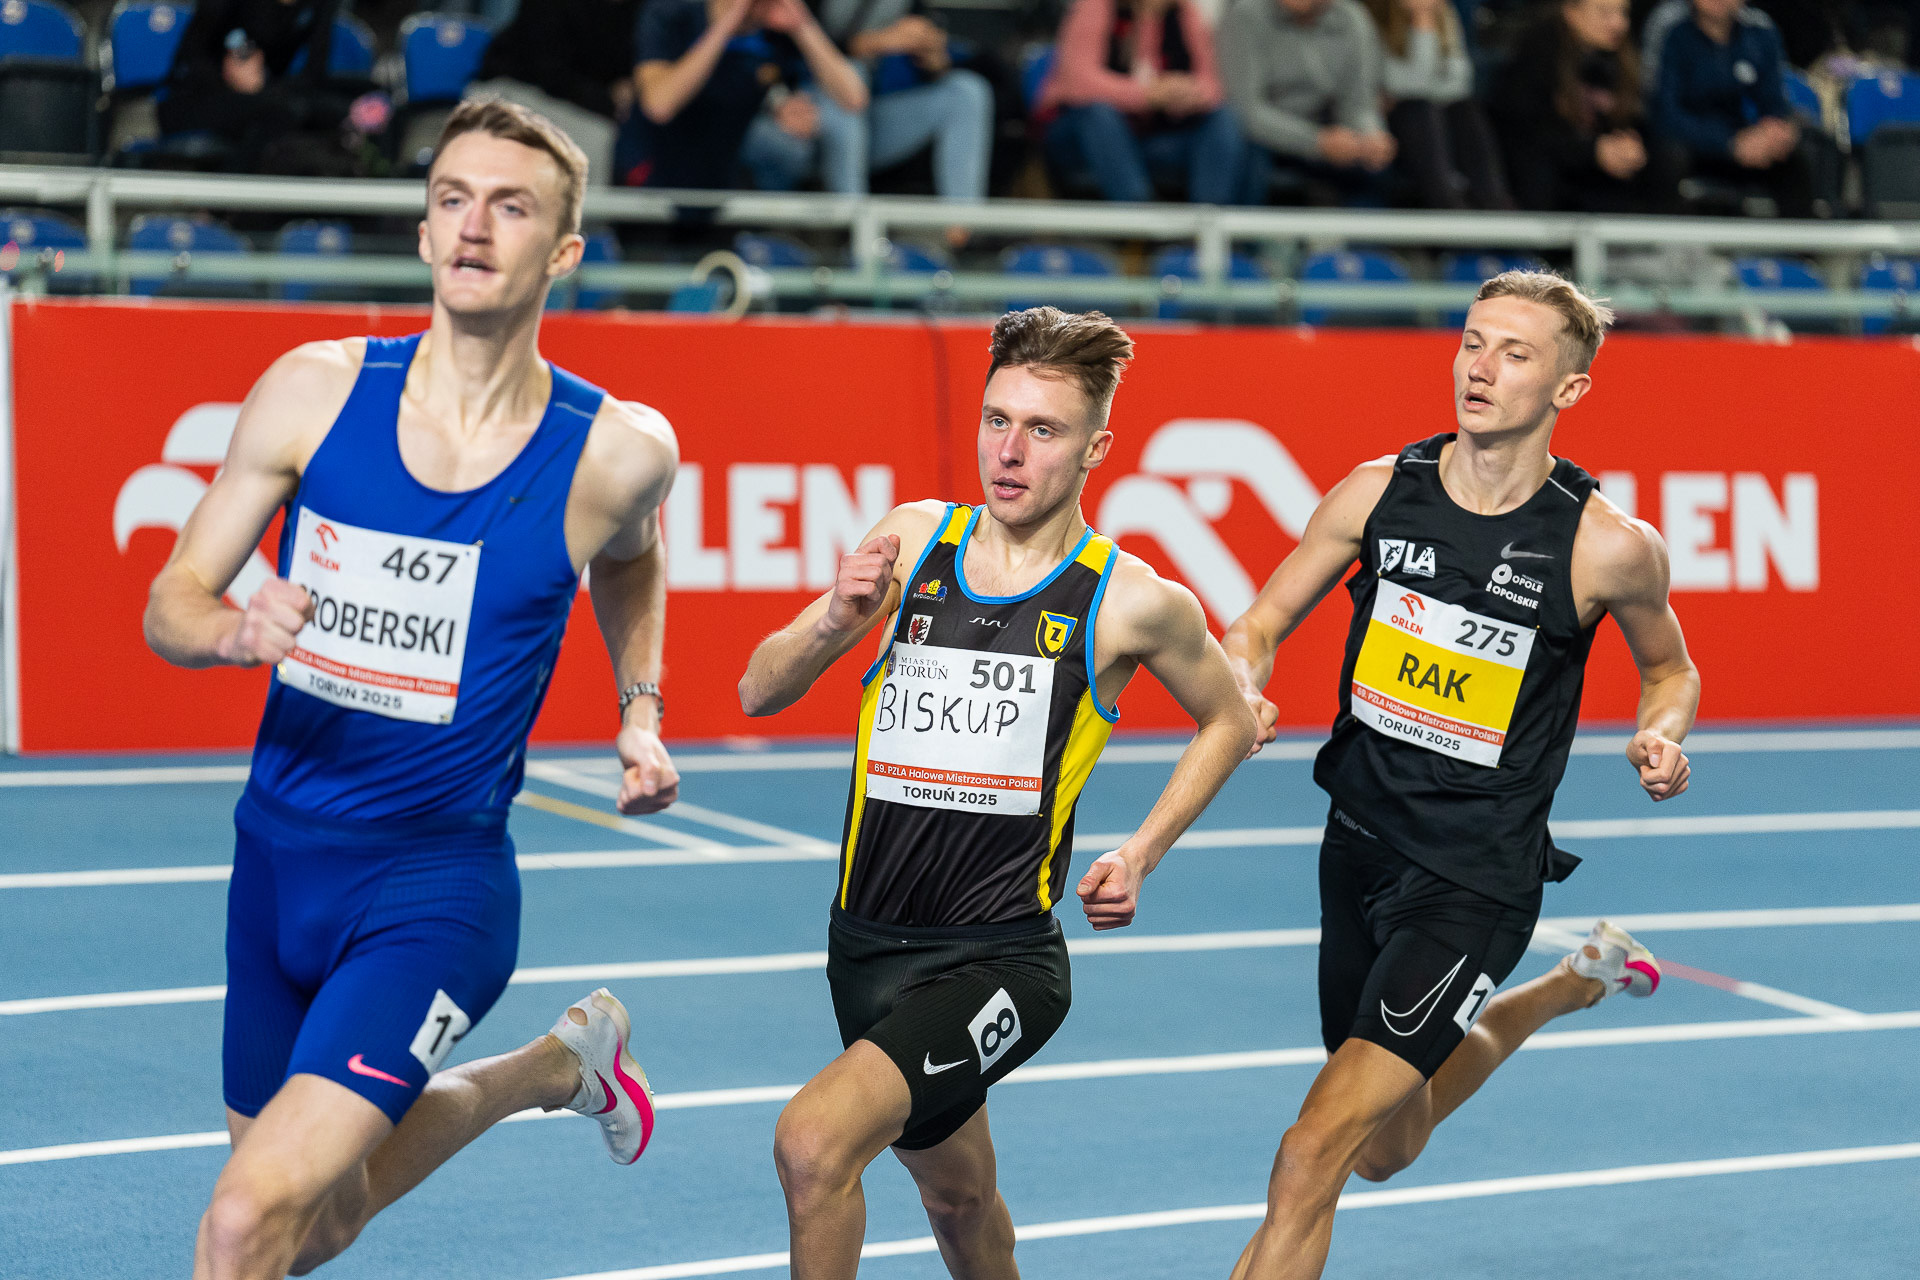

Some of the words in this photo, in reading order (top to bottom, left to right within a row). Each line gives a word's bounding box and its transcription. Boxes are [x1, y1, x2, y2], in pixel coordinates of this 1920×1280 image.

[660, 463, 896, 592] LEN
[382, 547, 458, 585] 467
[1492, 585, 1539, 610] OPOLSKIE
[1512, 575, 1543, 594] OPOLE
[302, 584, 456, 656] ROBERSKI
[1049, 627, 1062, 642] Z
[1391, 614, 1424, 636] ORLEN
[1454, 619, 1519, 657] 275
[899, 664, 949, 680] TORUŃ
[901, 657, 938, 666] MIASTO
[970, 659, 1036, 694] 501
[1397, 652, 1472, 703] RAK
[362, 690, 403, 709] 2025
[876, 683, 1020, 737] BISKUP
[1367, 692, 1385, 708] PZLA
[1385, 699, 1417, 719] Halowe
[1418, 711, 1472, 736] Mistrzostwa
[1473, 729, 1501, 743] Polski
[1377, 714, 1424, 740] TORUŃ
[1426, 731, 1462, 751] 2025
[874, 763, 887, 773] 69.
[888, 766, 907, 777] PZLA
[908, 769, 944, 781] Halowe
[946, 774, 1006, 787] Mistrzostwa
[1008, 778, 1038, 789] Polski
[902, 785, 955, 802] TORUŃ
[958, 791, 997, 806] 2025
[430, 1014, 467, 1056] 1
[980, 1007, 1016, 1058] 8
